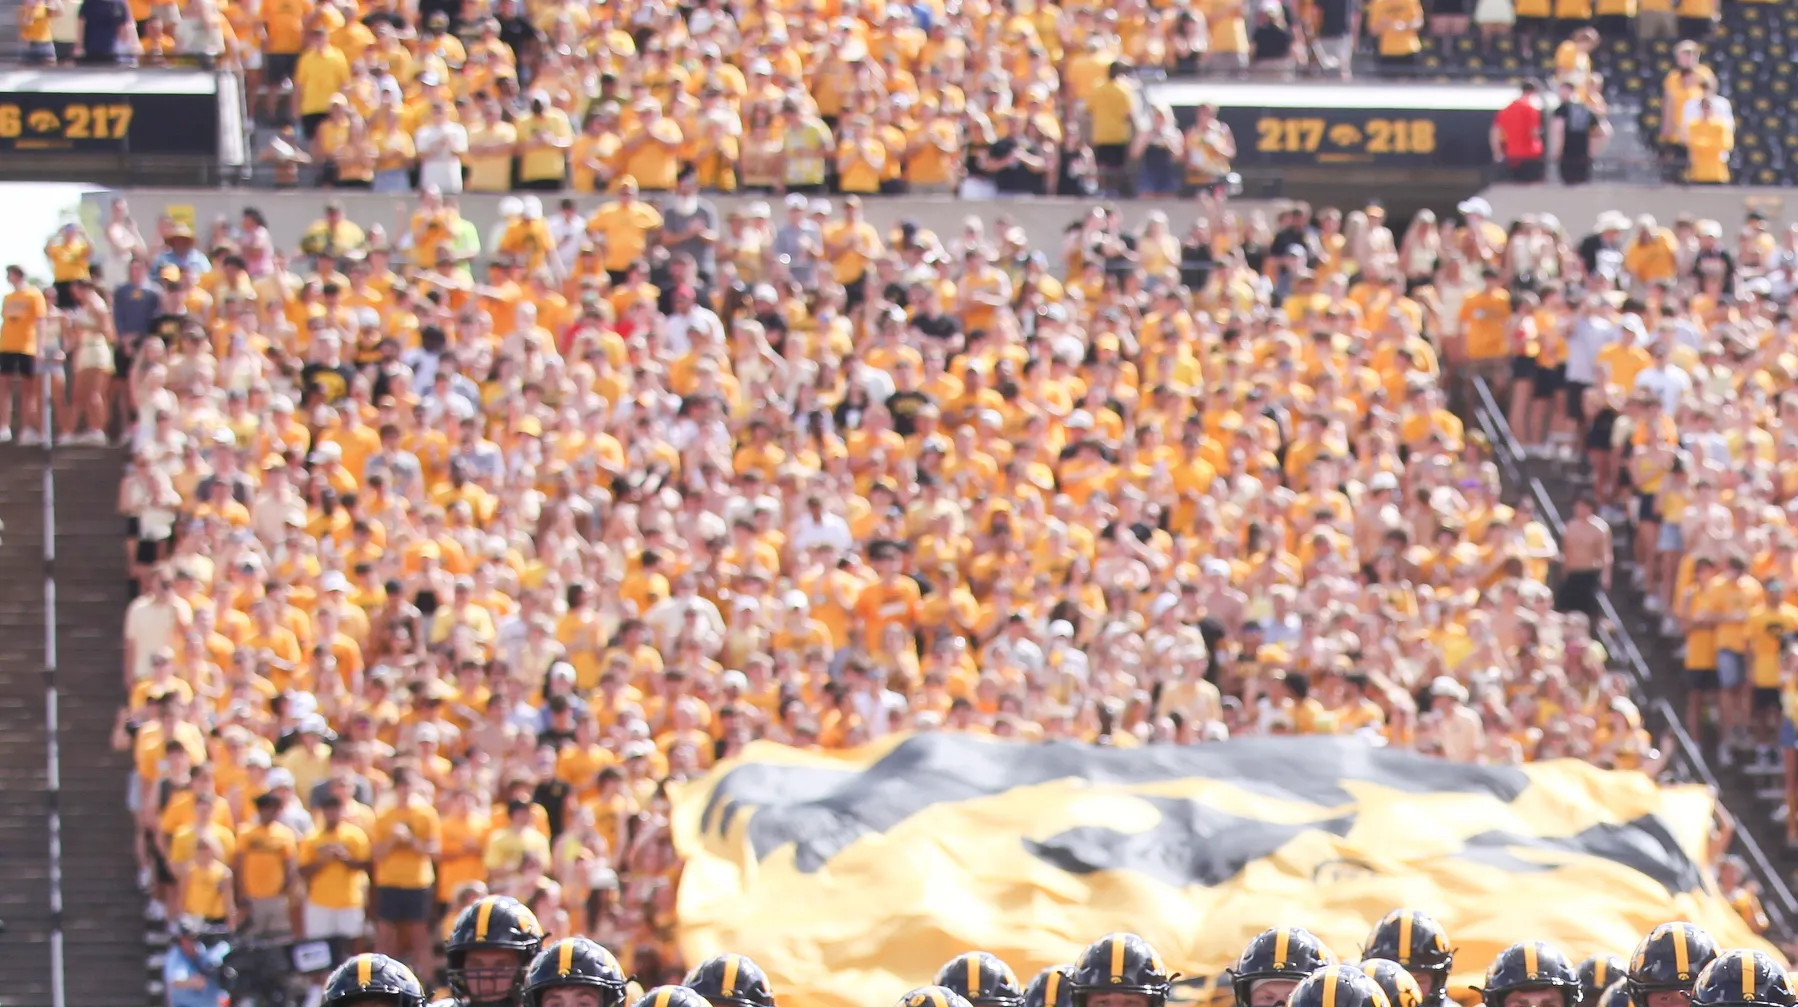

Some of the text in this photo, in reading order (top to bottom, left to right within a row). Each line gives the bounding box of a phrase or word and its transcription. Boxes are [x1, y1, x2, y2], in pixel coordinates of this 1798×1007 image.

[63, 103, 133, 138] 217
[1257, 118, 1436, 153] 217 218
